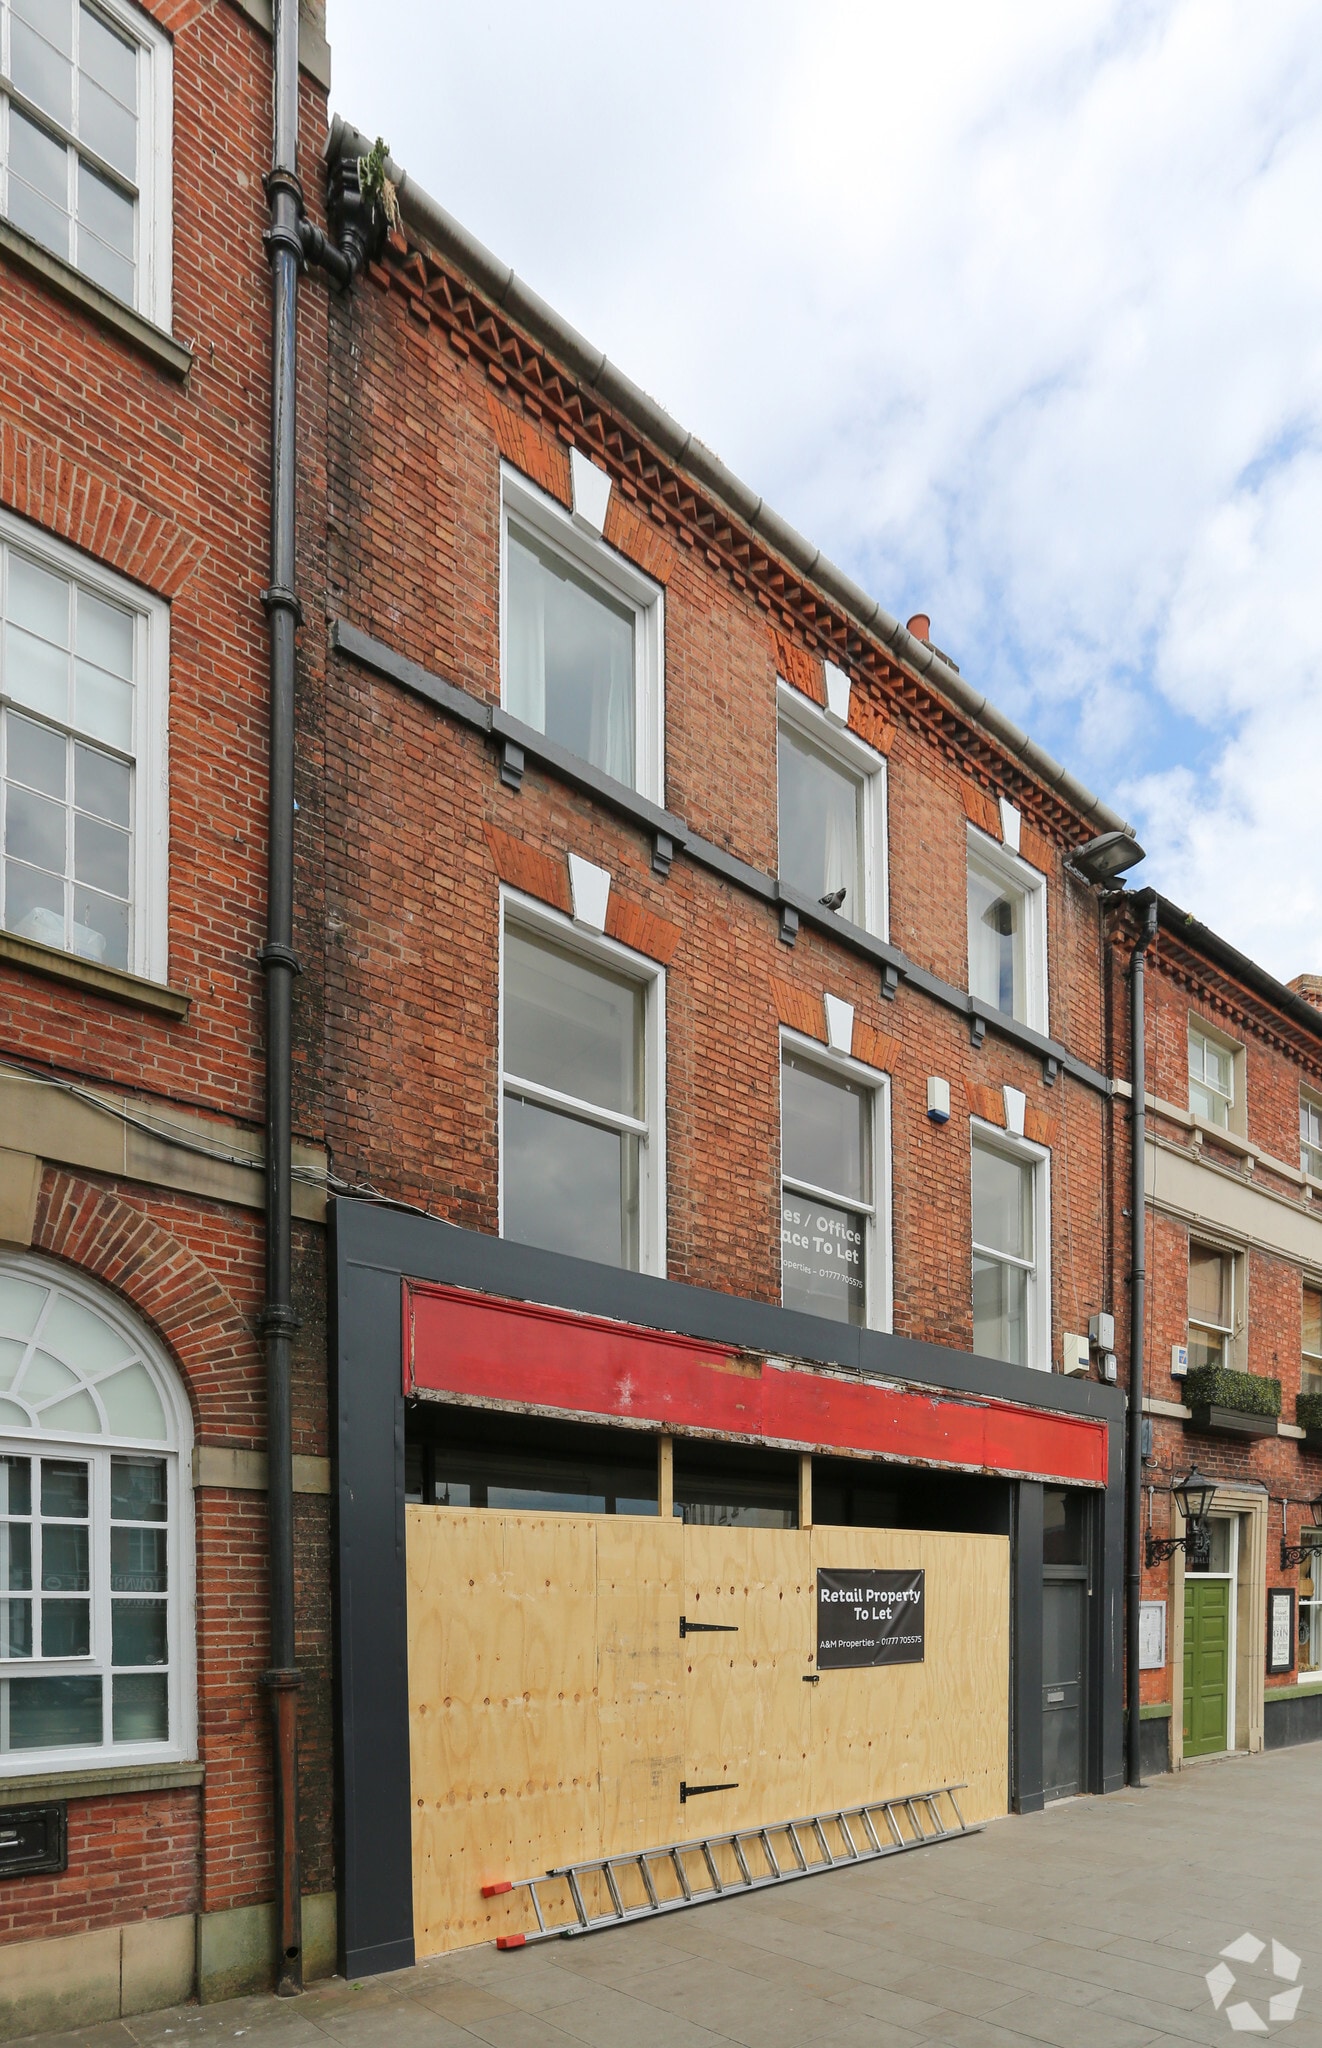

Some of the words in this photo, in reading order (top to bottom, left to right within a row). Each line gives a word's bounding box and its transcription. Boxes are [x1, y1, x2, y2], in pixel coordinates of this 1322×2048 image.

[784, 1209, 800, 1224] es
[816, 1216, 861, 1245] Office
[782, 1229, 809, 1249] ace
[812, 1236, 833, 1255] To
[837, 1243, 859, 1265] Let
[819, 1269, 841, 1280] 01777
[841, 1274, 863, 1289] 705575
[820, 1588, 863, 1603] Retail
[866, 1588, 921, 1605] Property
[853, 1607, 869, 1621] To
[872, 1607, 892, 1620] Let
[819, 1640, 837, 1649] A&M
[838, 1638, 875, 1649] Properties
[881, 1636, 898, 1646] 01777
[899, 1635, 922, 1645] 705575
[1273, 1629, 1288, 1638] GIN
